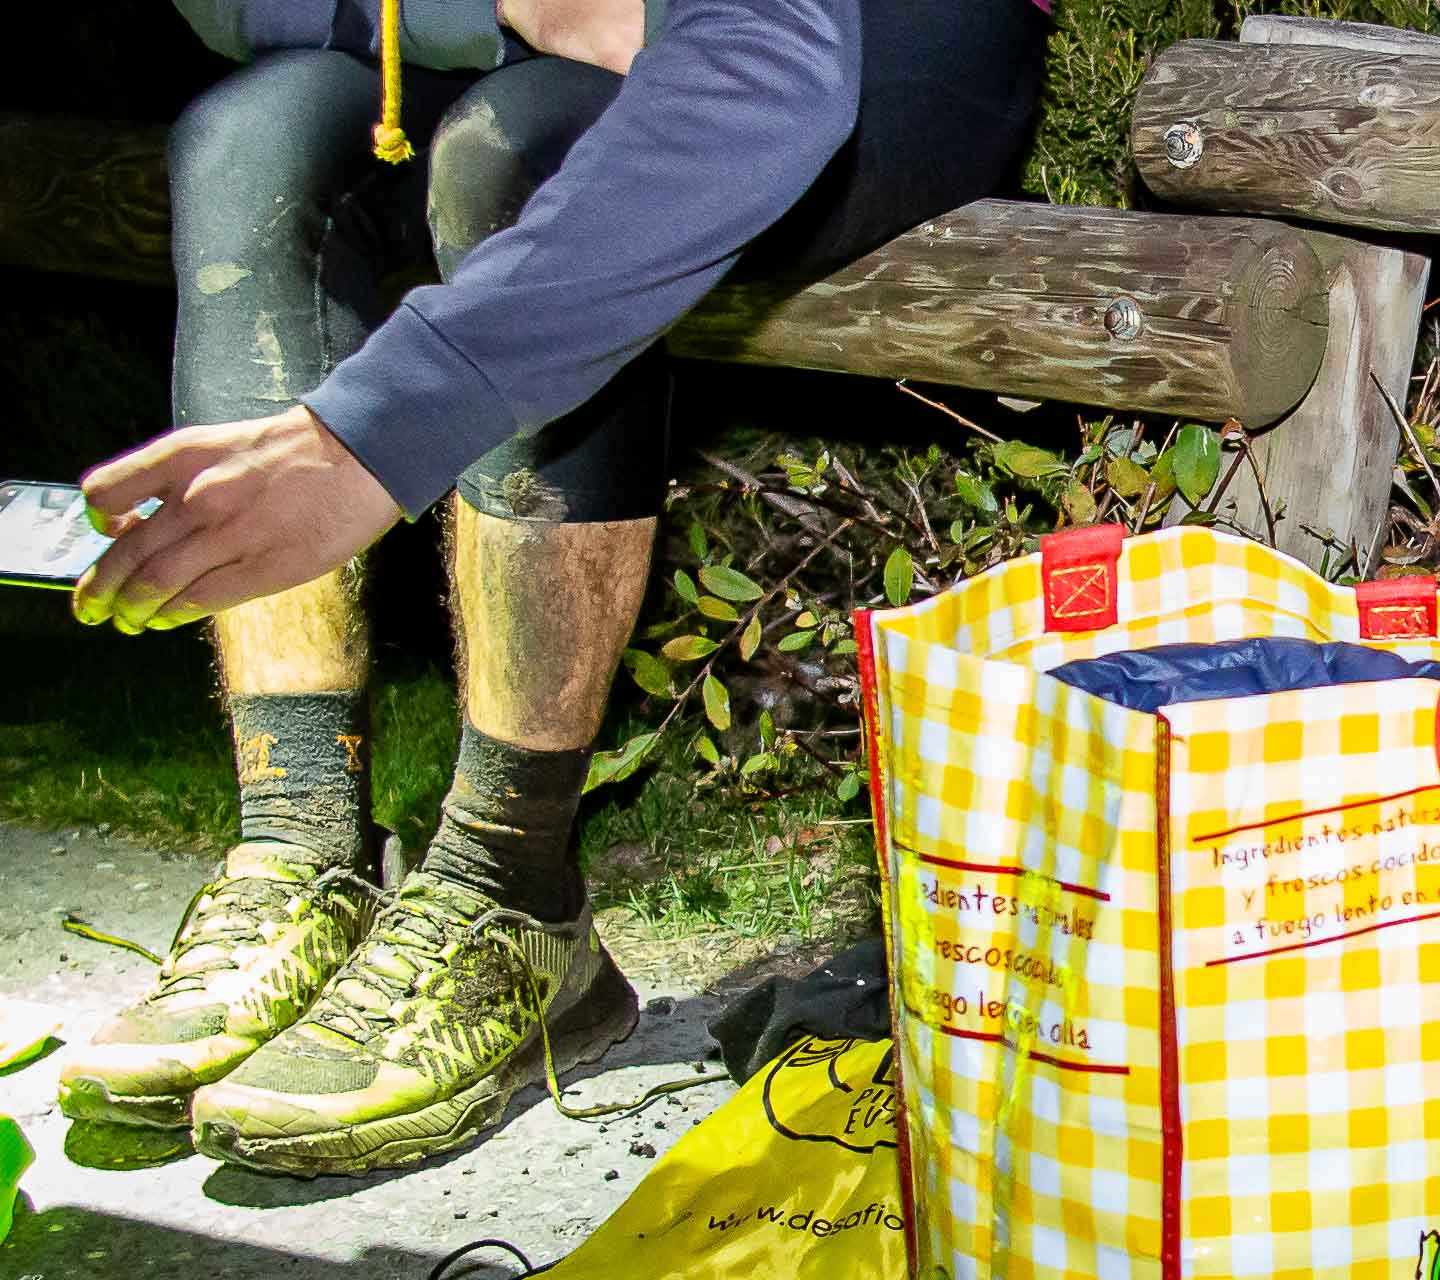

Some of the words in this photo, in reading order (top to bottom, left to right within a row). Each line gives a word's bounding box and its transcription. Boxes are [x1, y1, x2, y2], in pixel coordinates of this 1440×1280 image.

[1212, 824, 1364, 870] Ingredientes
[1266, 864, 1364, 896] frescos
[1255, 912, 1326, 939] fuego
[1335, 894, 1393, 923] lento
[1402, 887, 1428, 905] en
